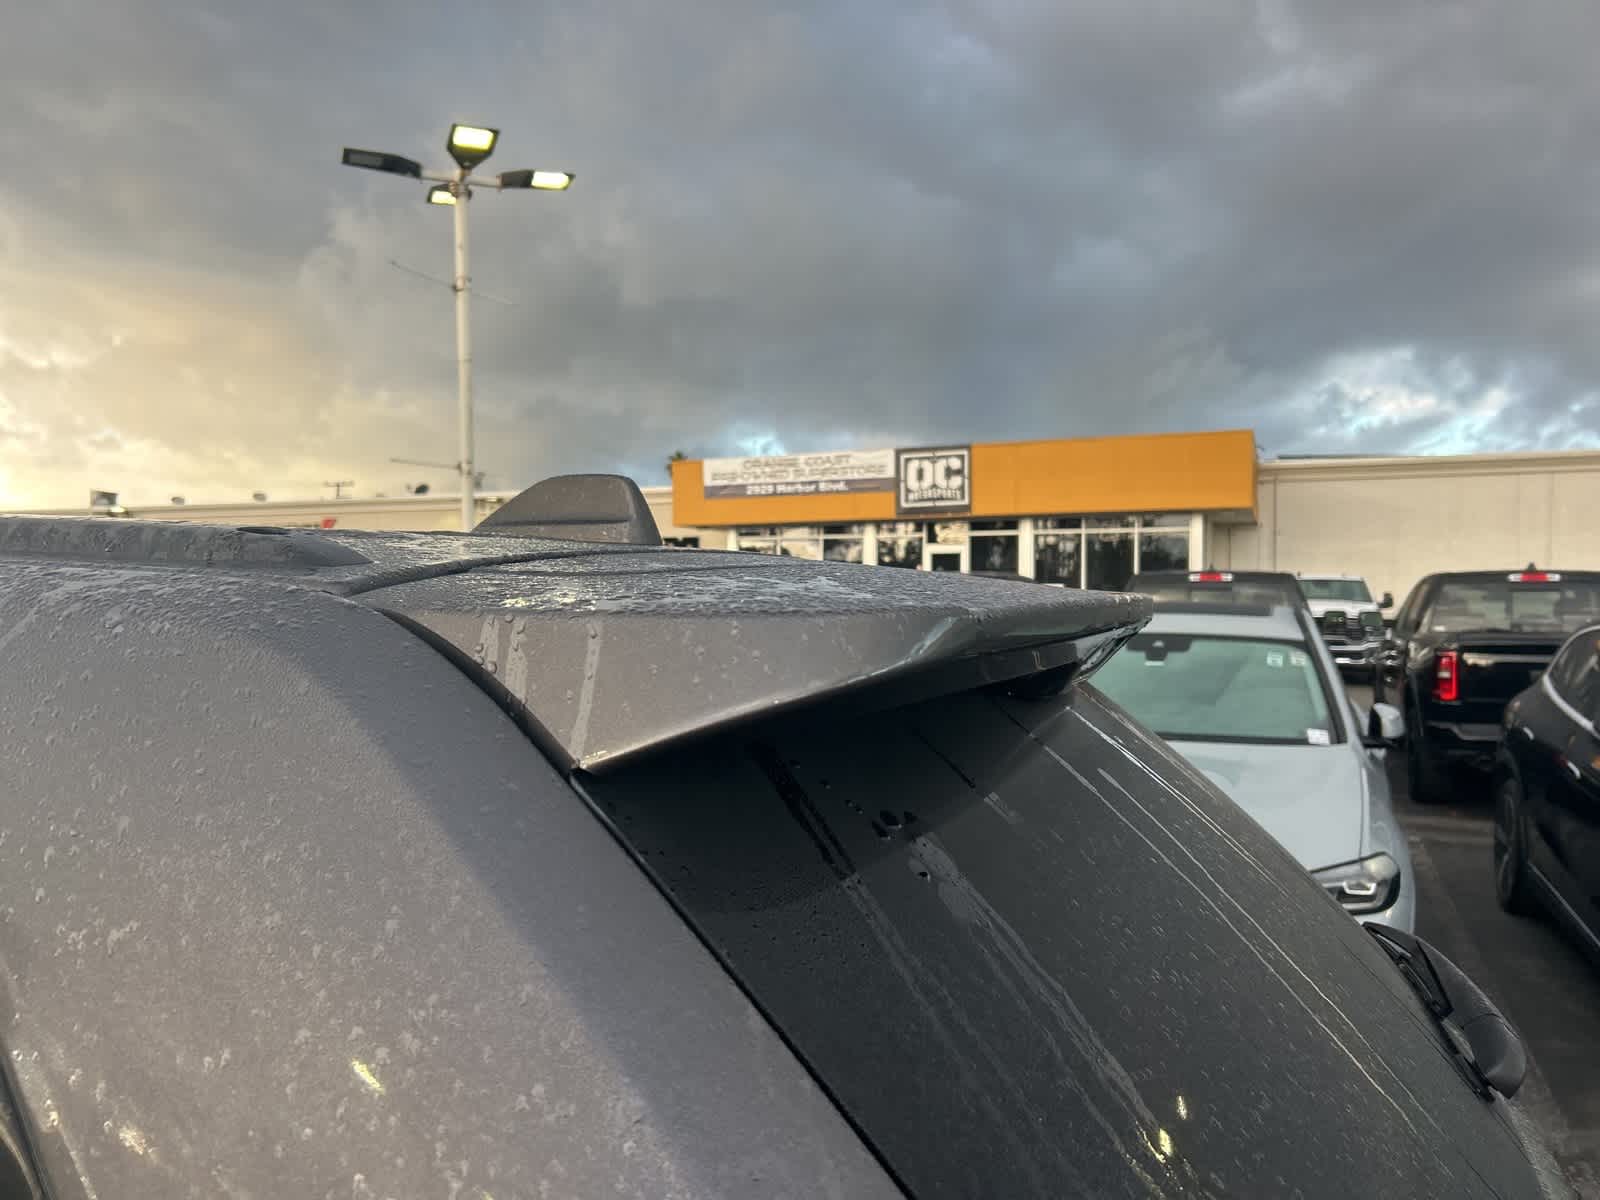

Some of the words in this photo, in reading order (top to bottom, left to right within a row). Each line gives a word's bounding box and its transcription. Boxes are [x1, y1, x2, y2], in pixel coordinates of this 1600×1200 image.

[805, 455, 852, 467] COAST
[906, 456, 962, 490] OC
[776, 482, 817, 495] Harbor
